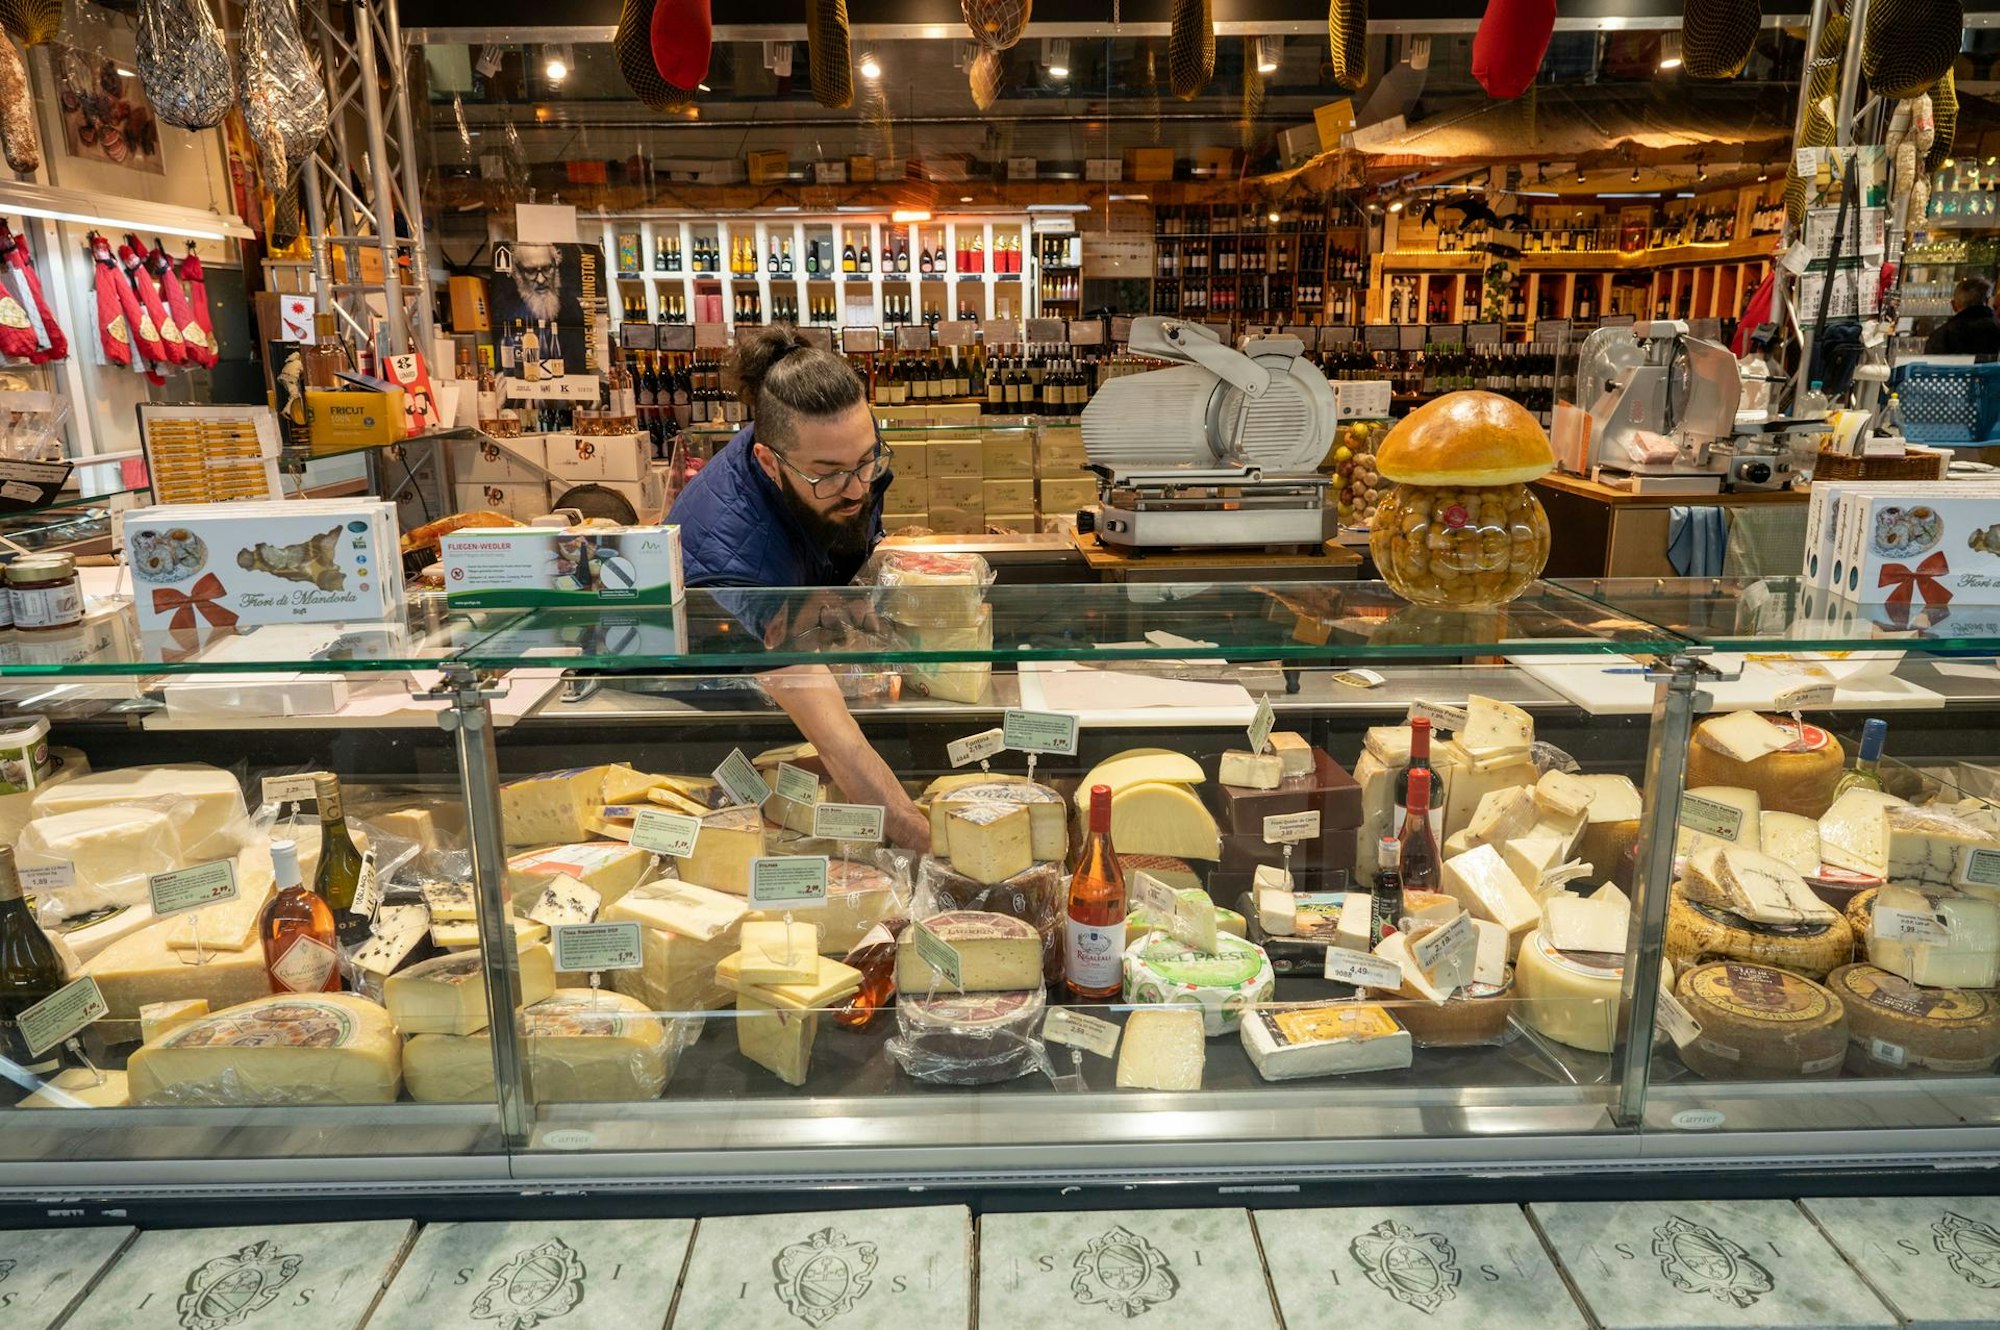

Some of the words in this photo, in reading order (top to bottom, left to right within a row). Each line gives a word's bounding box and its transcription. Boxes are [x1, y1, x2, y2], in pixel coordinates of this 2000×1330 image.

[330, 406, 364, 415] FRICUT
[448, 542, 511, 550] FLIEGEN-WEDLER
[240, 593, 274, 608] Fiori
[276, 594, 288, 605] di
[290, 590, 357, 605] Mandorla
[965, 737, 989, 748] Fontina
